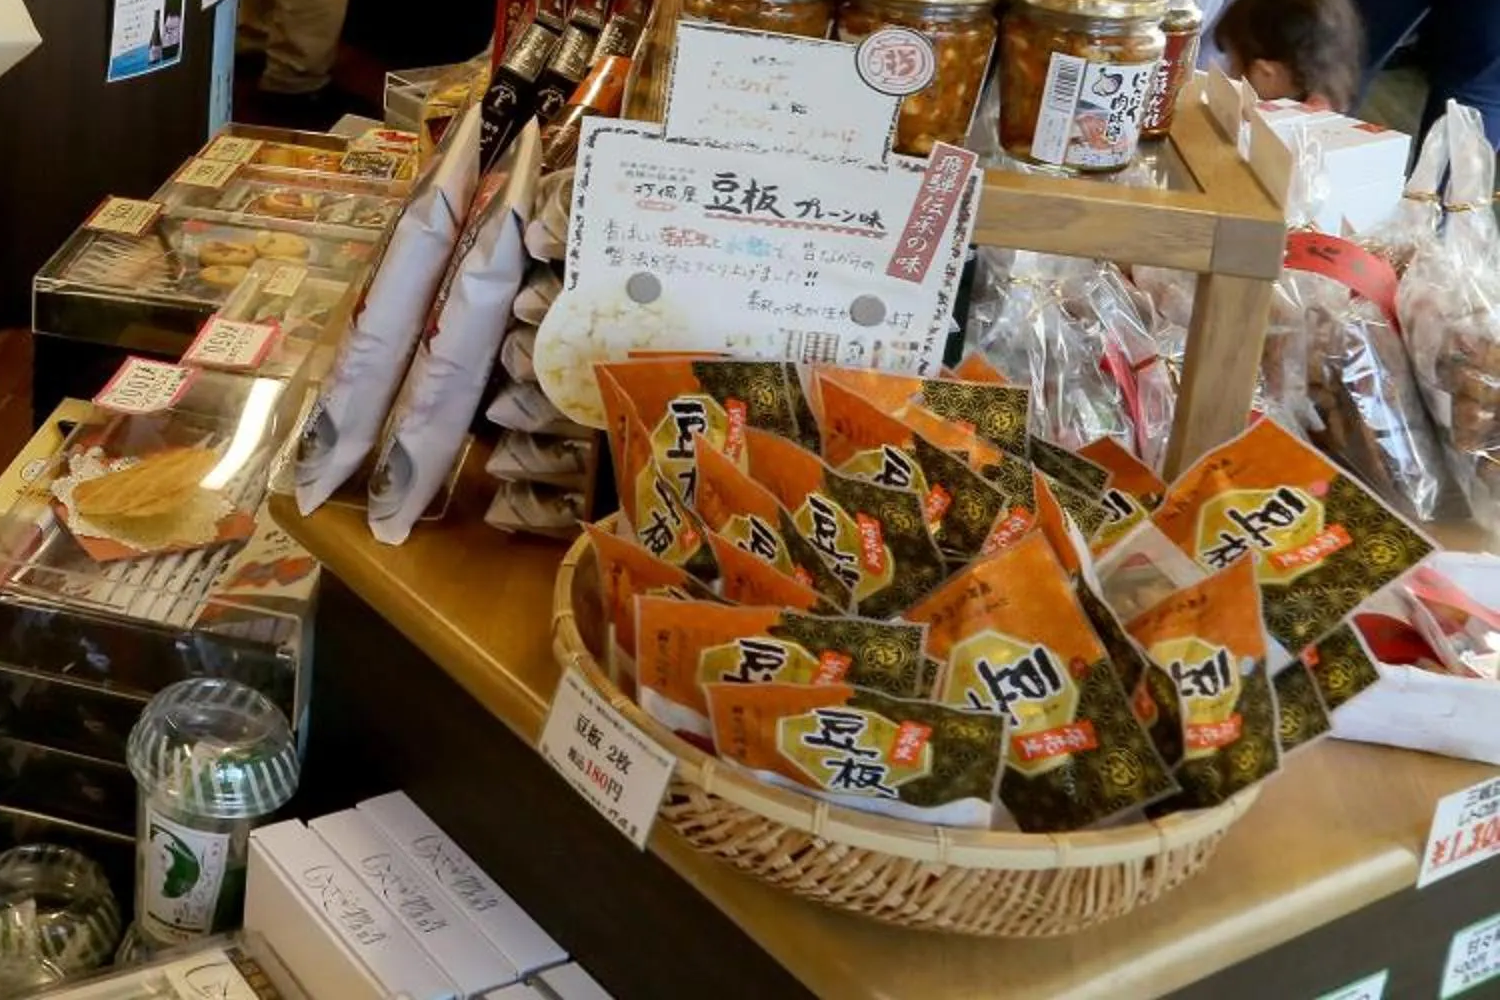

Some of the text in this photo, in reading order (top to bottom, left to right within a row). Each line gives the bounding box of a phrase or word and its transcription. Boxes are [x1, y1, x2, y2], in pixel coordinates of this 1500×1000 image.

[704, 171, 786, 219] 豆板
[793, 197, 886, 231] プレーン味
[576, 713, 634, 776] 豆板 2枚
[803, 707, 897, 797] 豆板
